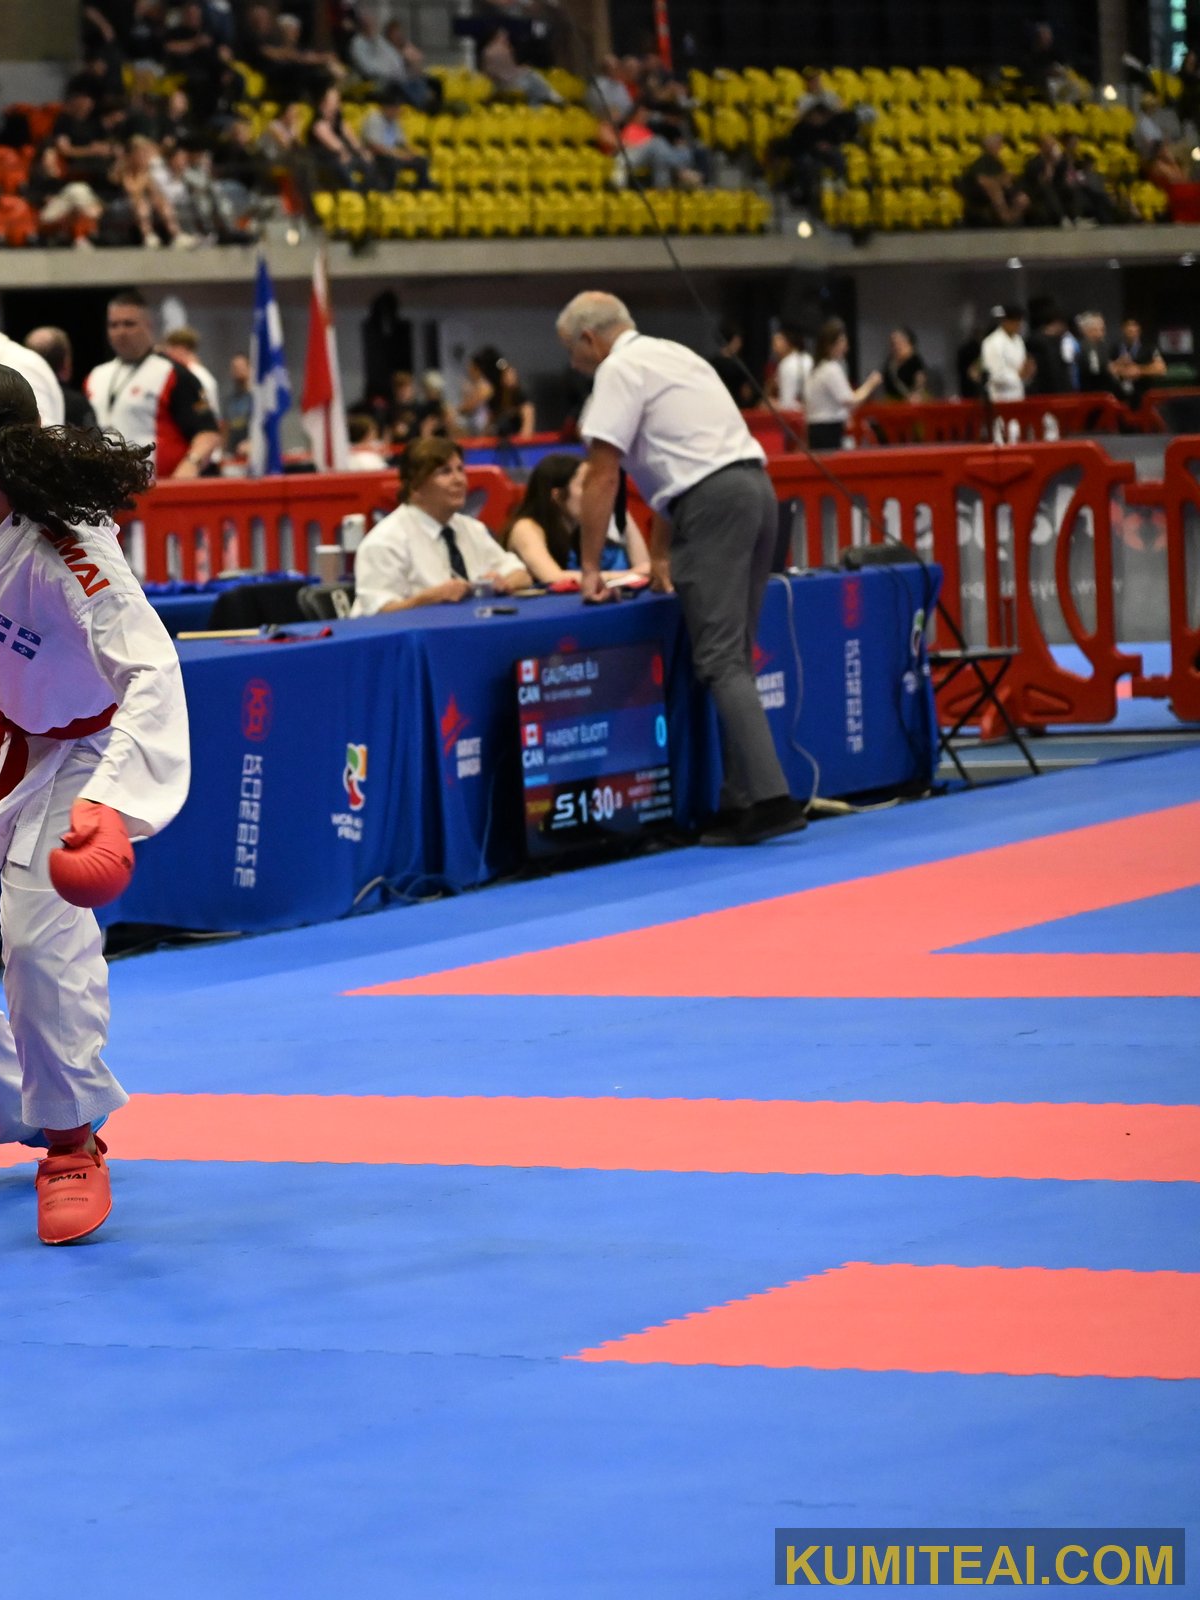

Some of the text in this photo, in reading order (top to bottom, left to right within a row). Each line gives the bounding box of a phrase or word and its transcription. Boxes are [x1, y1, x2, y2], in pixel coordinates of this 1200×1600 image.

[518, 686, 541, 705] CAN
[655, 714, 668, 747] 0
[522, 749, 545, 768] CAN
[48, 1172, 87, 1184] SMAI
